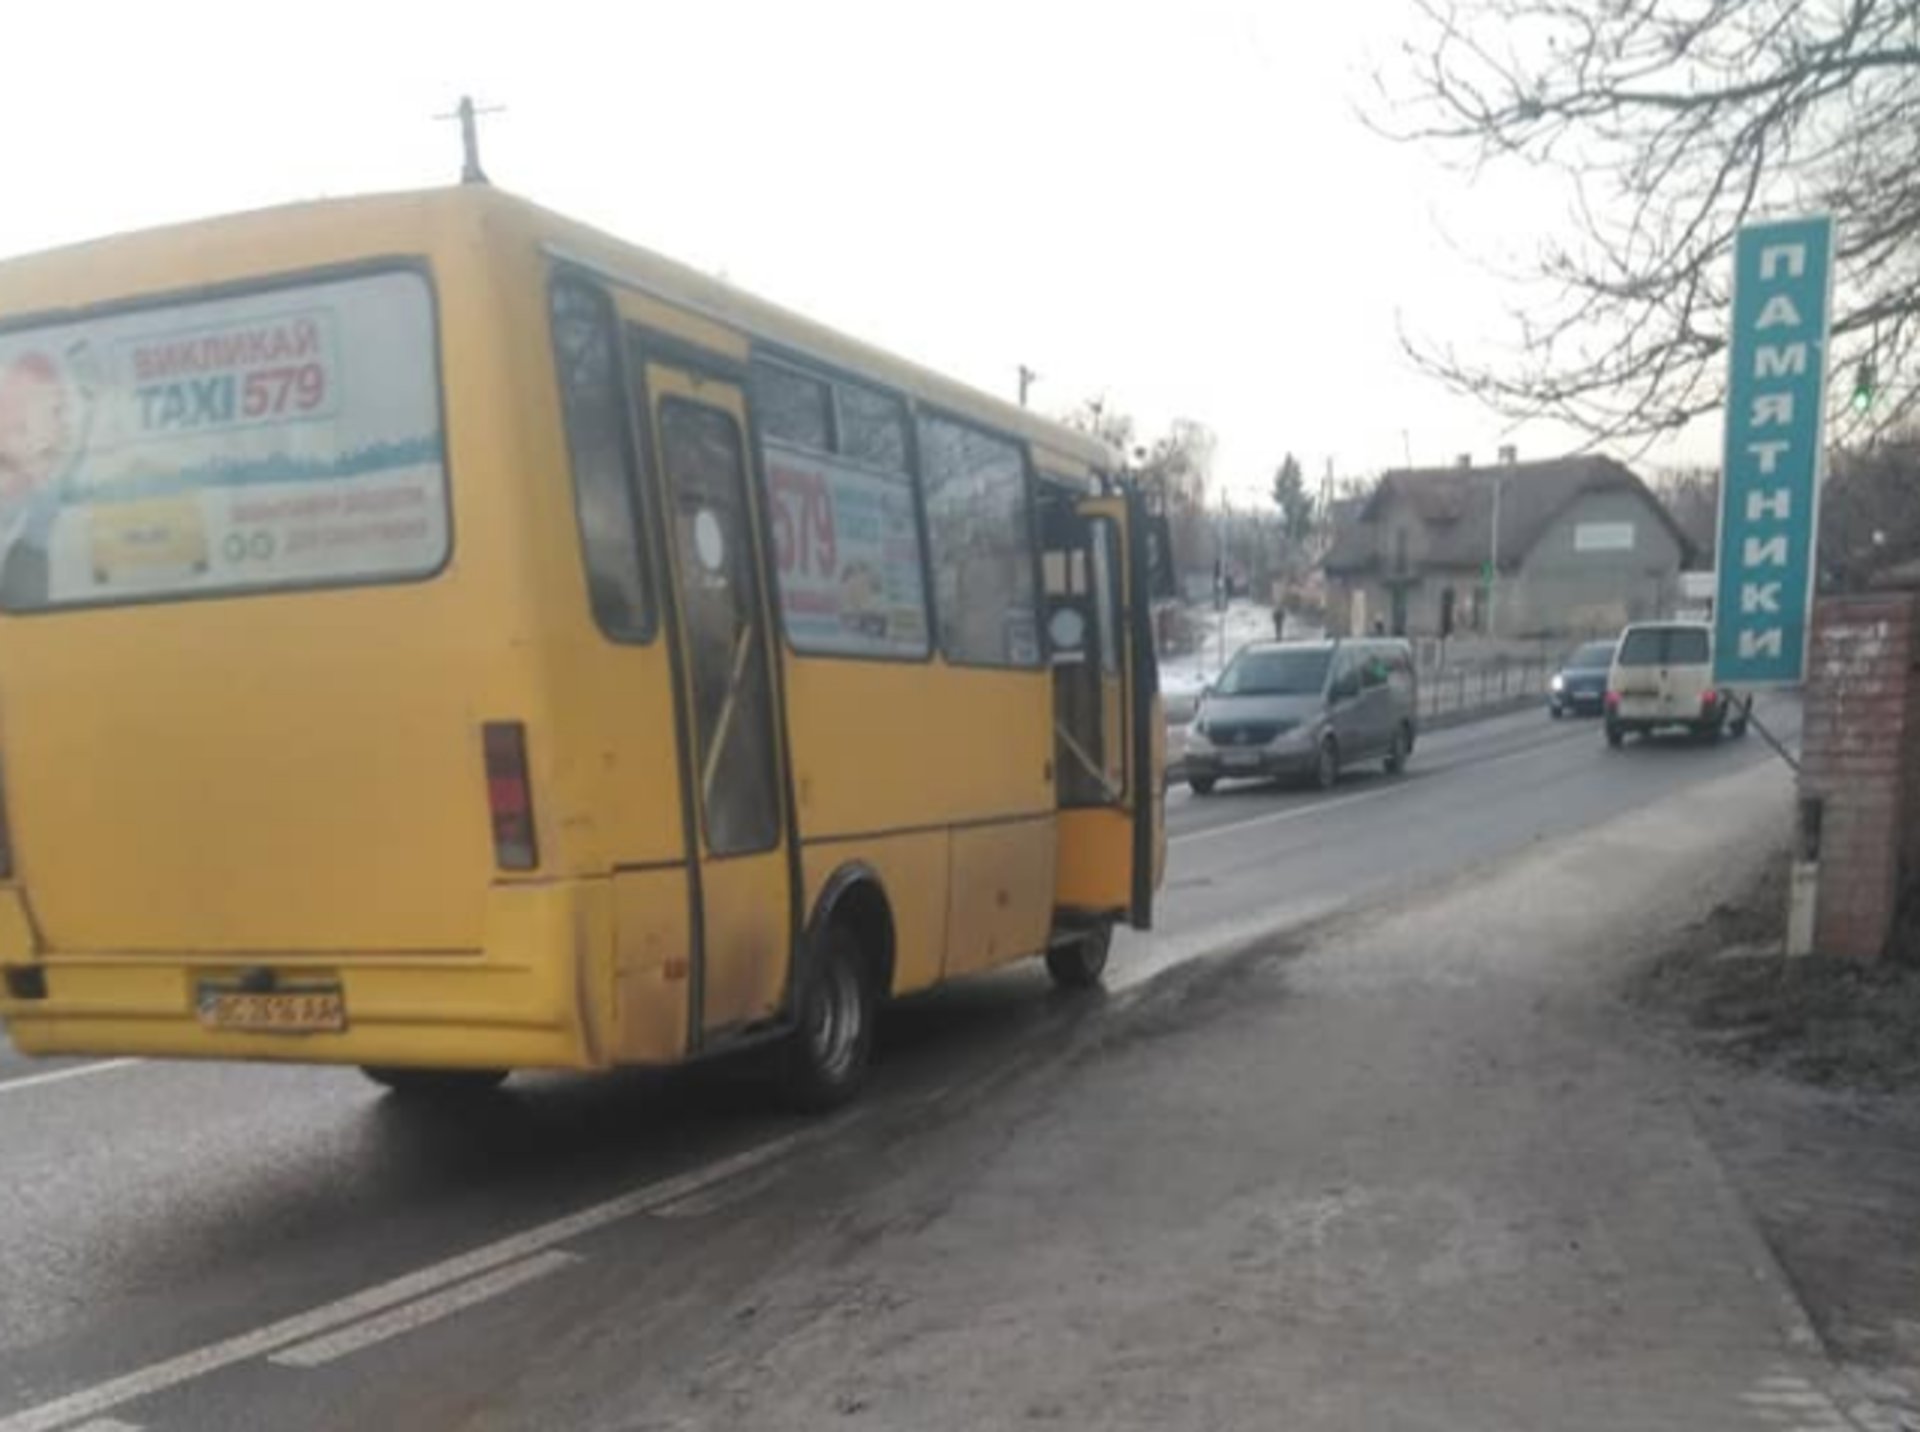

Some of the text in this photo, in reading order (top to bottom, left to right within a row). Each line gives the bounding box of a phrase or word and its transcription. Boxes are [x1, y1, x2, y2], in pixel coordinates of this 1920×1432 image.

[136, 363, 325, 430] TAXI 579
[1737, 243, 1807, 660] ПАМЯТНИКИ
